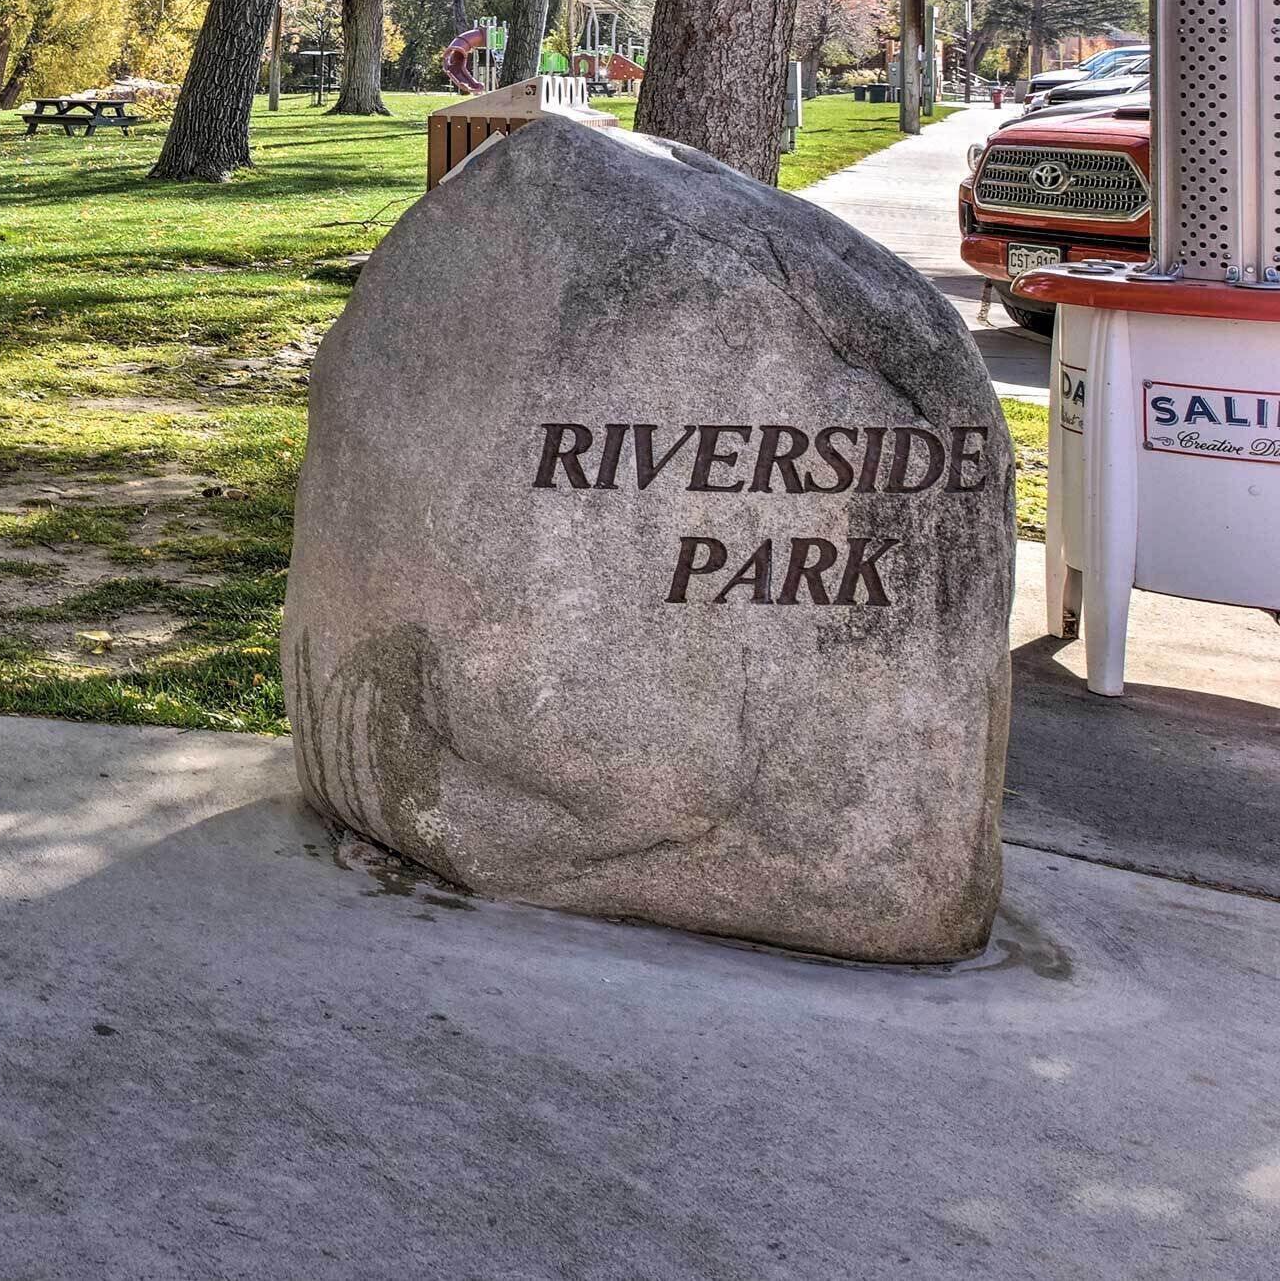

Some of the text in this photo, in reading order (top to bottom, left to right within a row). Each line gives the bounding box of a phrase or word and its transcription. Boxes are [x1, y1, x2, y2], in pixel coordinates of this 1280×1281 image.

[1150, 395, 1280, 429] SALI
[532, 423, 988, 494] RIVERSIDE
[1177, 430, 1244, 455] Creative
[665, 536, 901, 606] PARK
